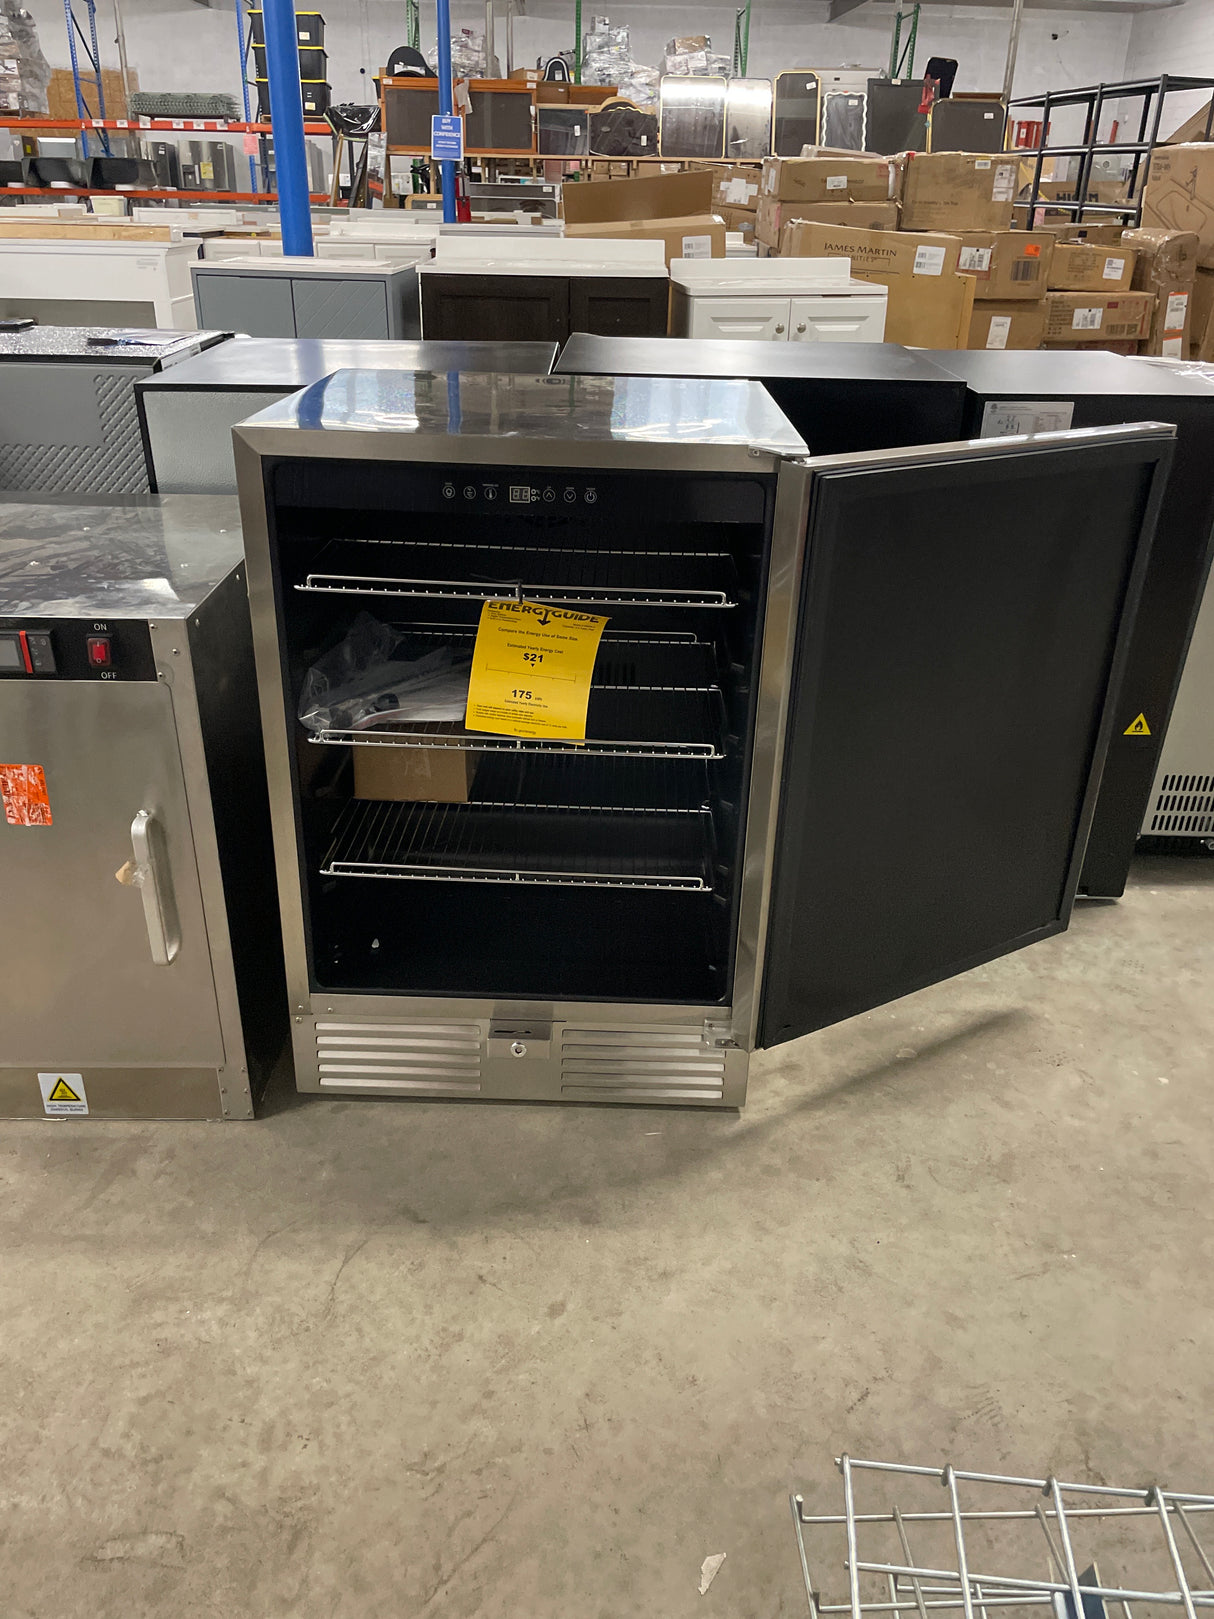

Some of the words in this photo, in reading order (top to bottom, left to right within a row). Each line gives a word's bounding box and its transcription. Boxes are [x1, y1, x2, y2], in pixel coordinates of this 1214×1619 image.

[824, 242, 855, 253] JAMES
[857, 245, 898, 257] MARTIN
[488, 601, 600, 625] ENERGYGUIDE
[93, 623, 107, 631] ON
[498, 626, 518, 634] Compare
[526, 630, 541, 638] Energy
[540, 646, 554, 654] Energy
[523, 652, 544, 663] $21
[100, 671, 117, 680] OFF
[511, 689, 532, 700] 175
